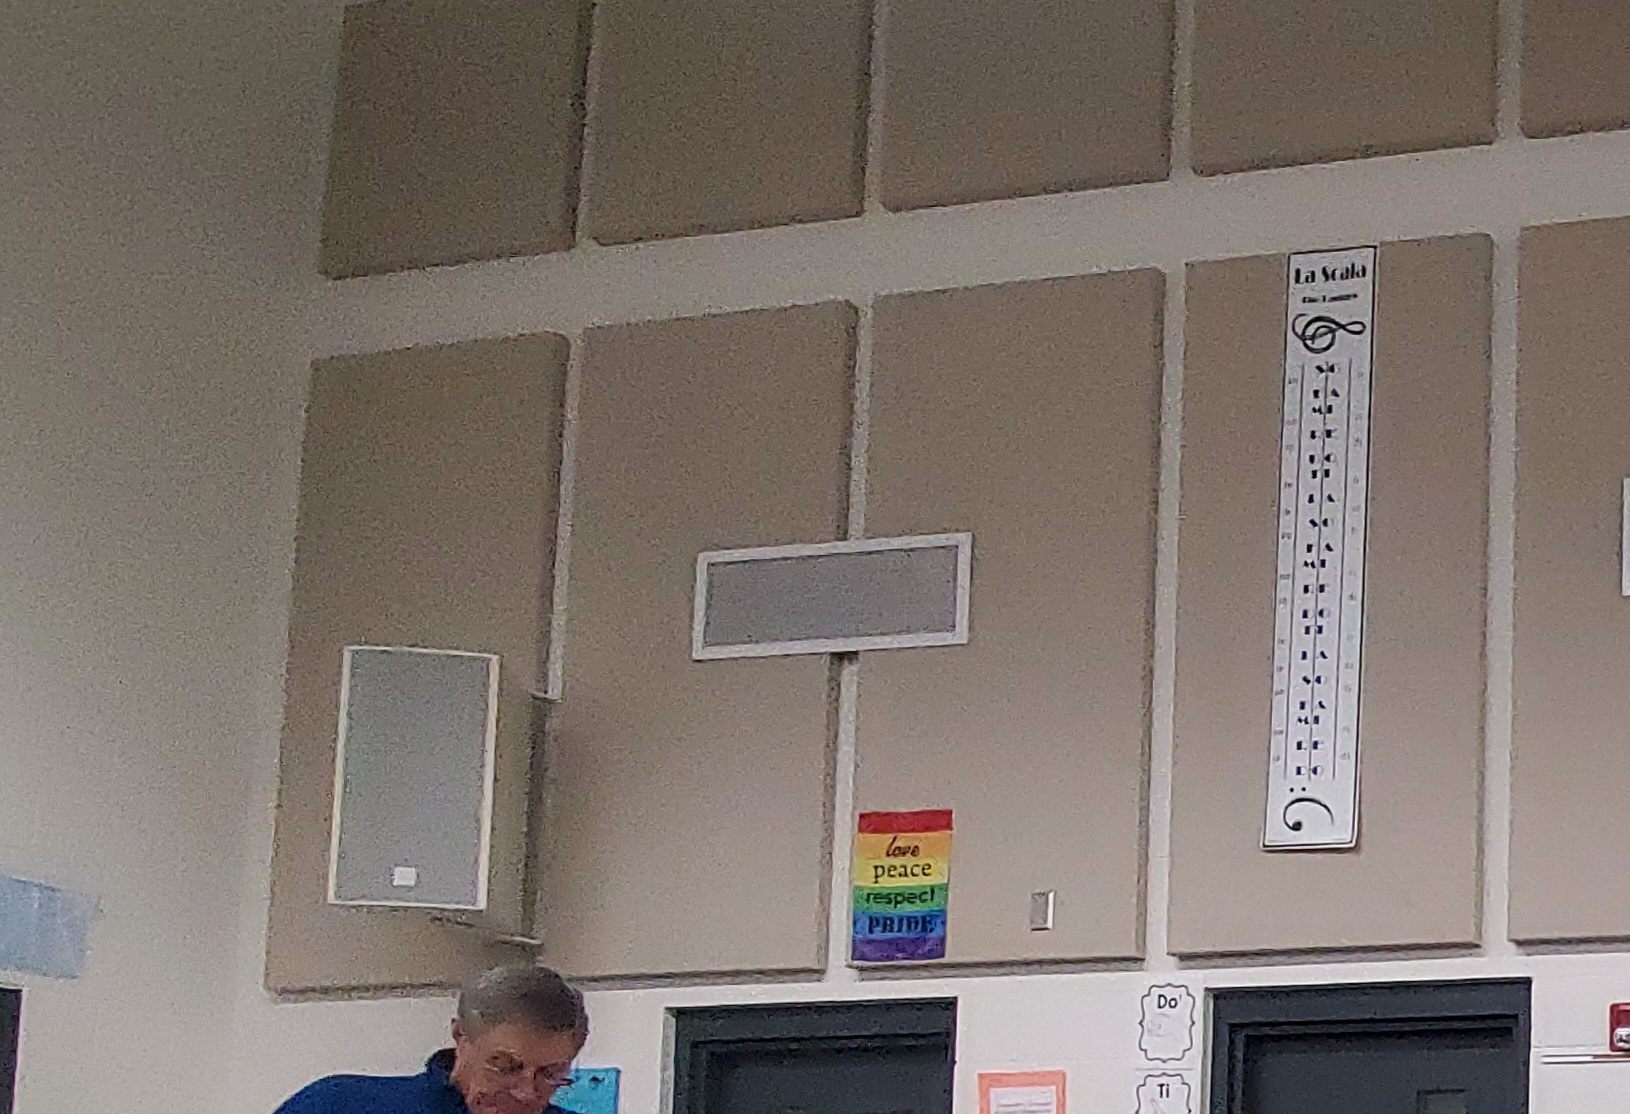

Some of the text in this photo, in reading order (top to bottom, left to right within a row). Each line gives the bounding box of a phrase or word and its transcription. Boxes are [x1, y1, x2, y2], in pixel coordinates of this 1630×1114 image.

[1294, 263, 1366, 285] La Scala
[886, 836, 920, 857] love
[872, 862, 932, 884] peace
[865, 888, 935, 909] respect
[868, 915, 936, 935] PRIDE
[1157, 1083, 1170, 1098] Ti
